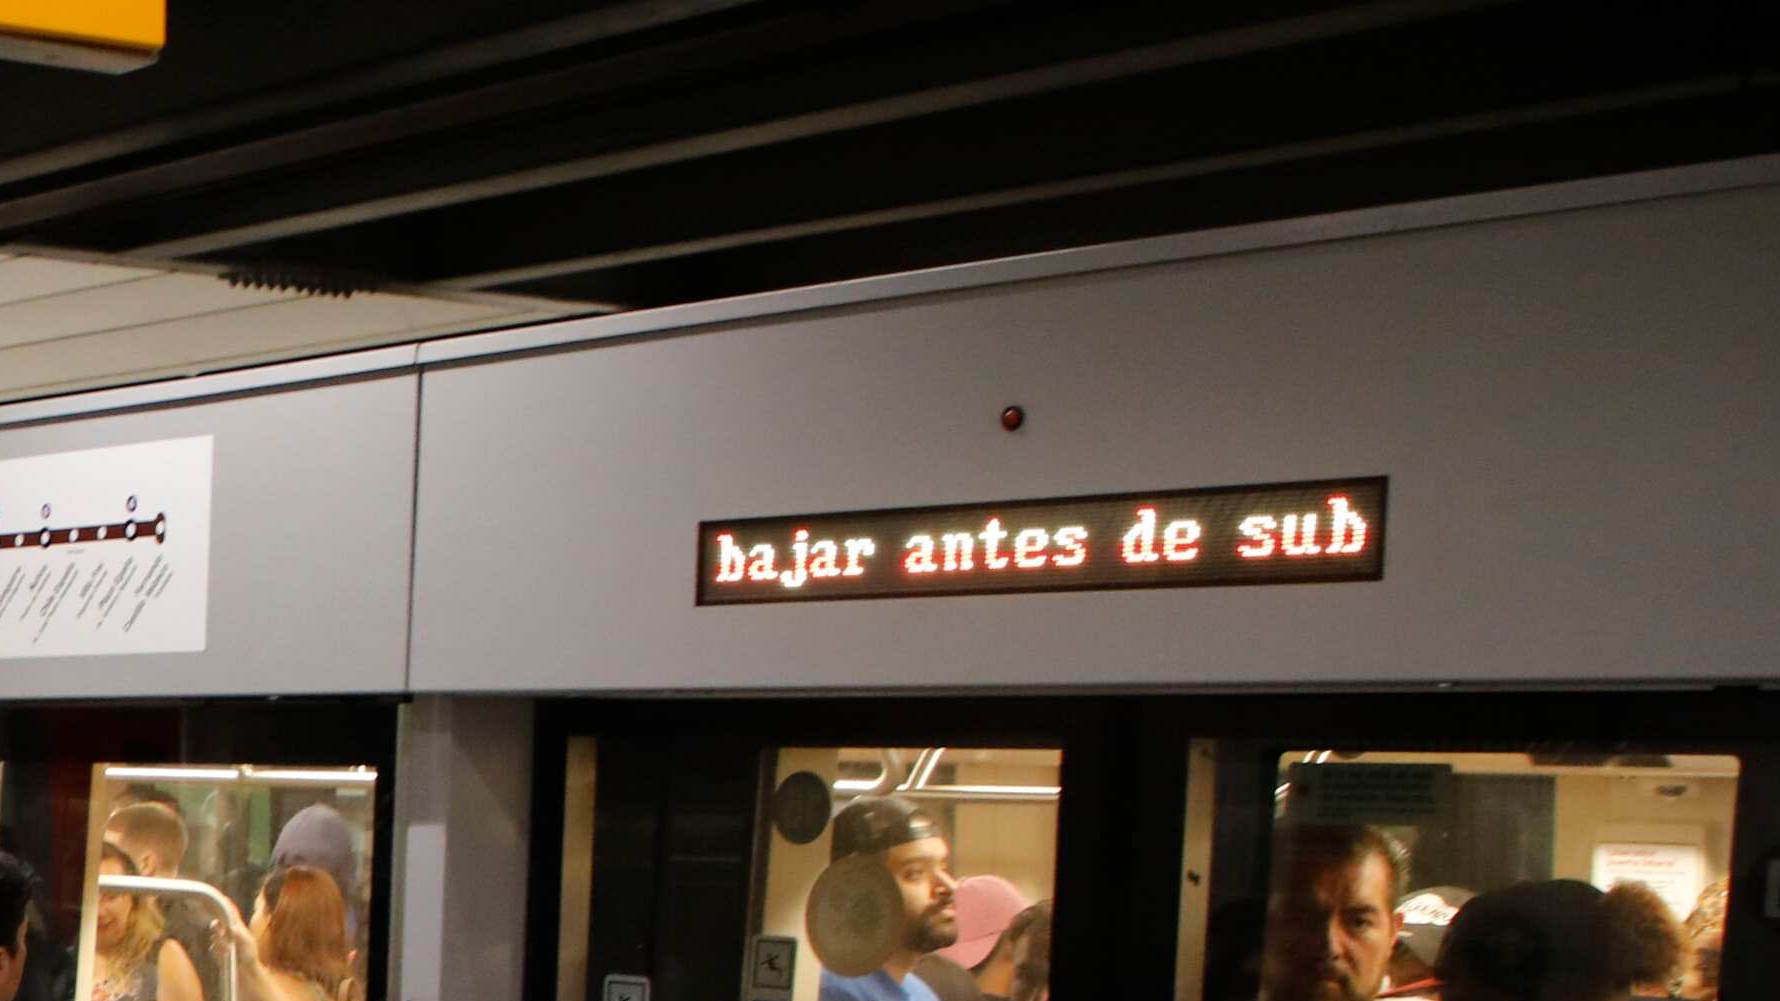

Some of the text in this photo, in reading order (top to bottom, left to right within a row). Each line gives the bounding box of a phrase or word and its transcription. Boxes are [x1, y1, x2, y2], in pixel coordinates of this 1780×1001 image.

[715, 495, 1368, 588] bajar antes de sub
